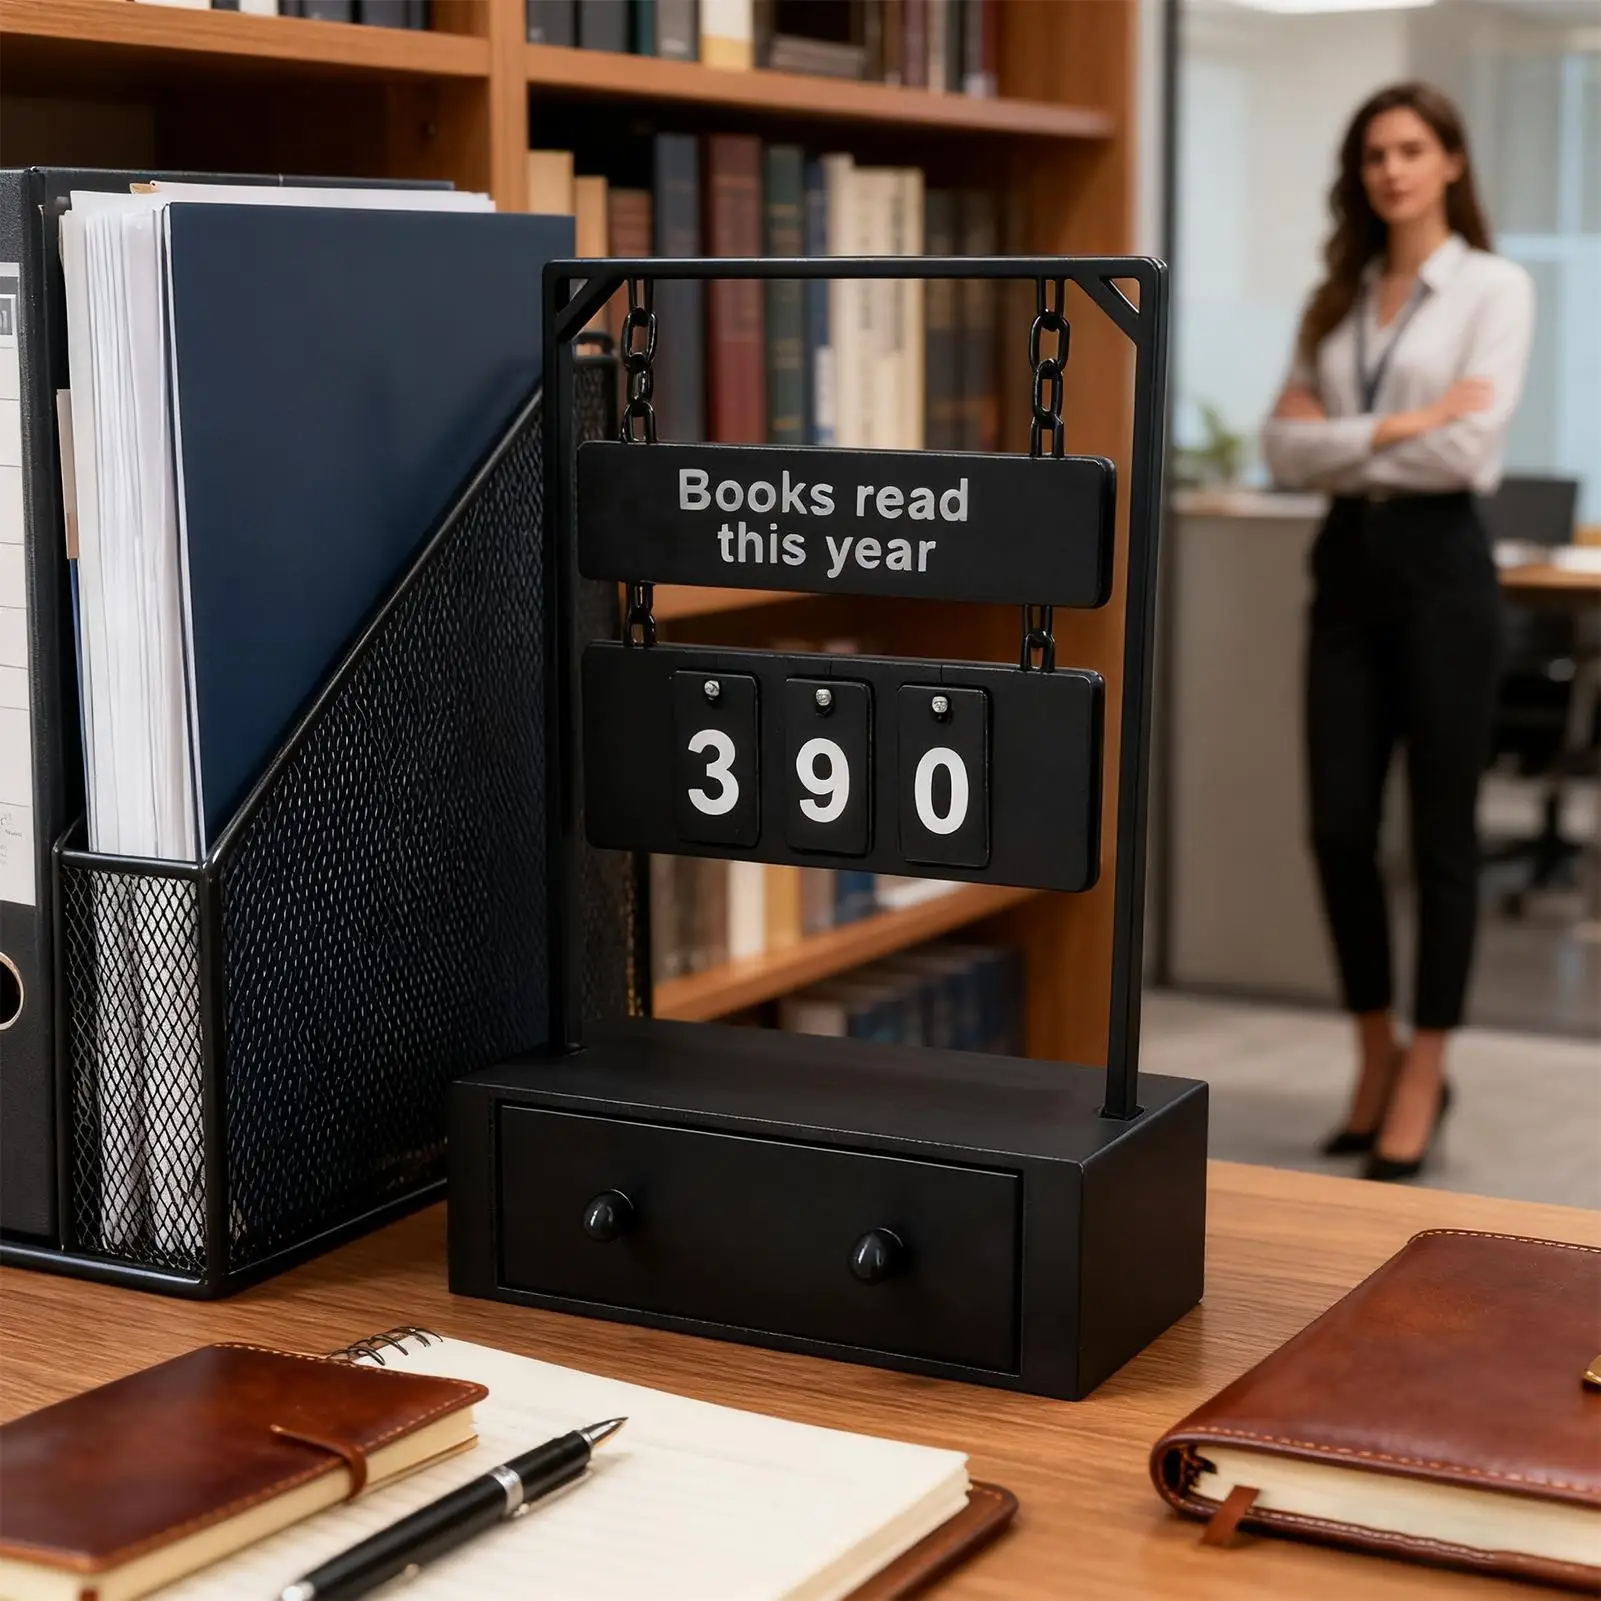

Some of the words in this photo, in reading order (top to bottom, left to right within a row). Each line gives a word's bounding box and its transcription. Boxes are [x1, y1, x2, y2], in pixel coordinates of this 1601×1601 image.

[679, 468, 836, 517] Books
[857, 478, 969, 523] read
[717, 523, 807, 567] this
[826, 536, 937, 579] year
